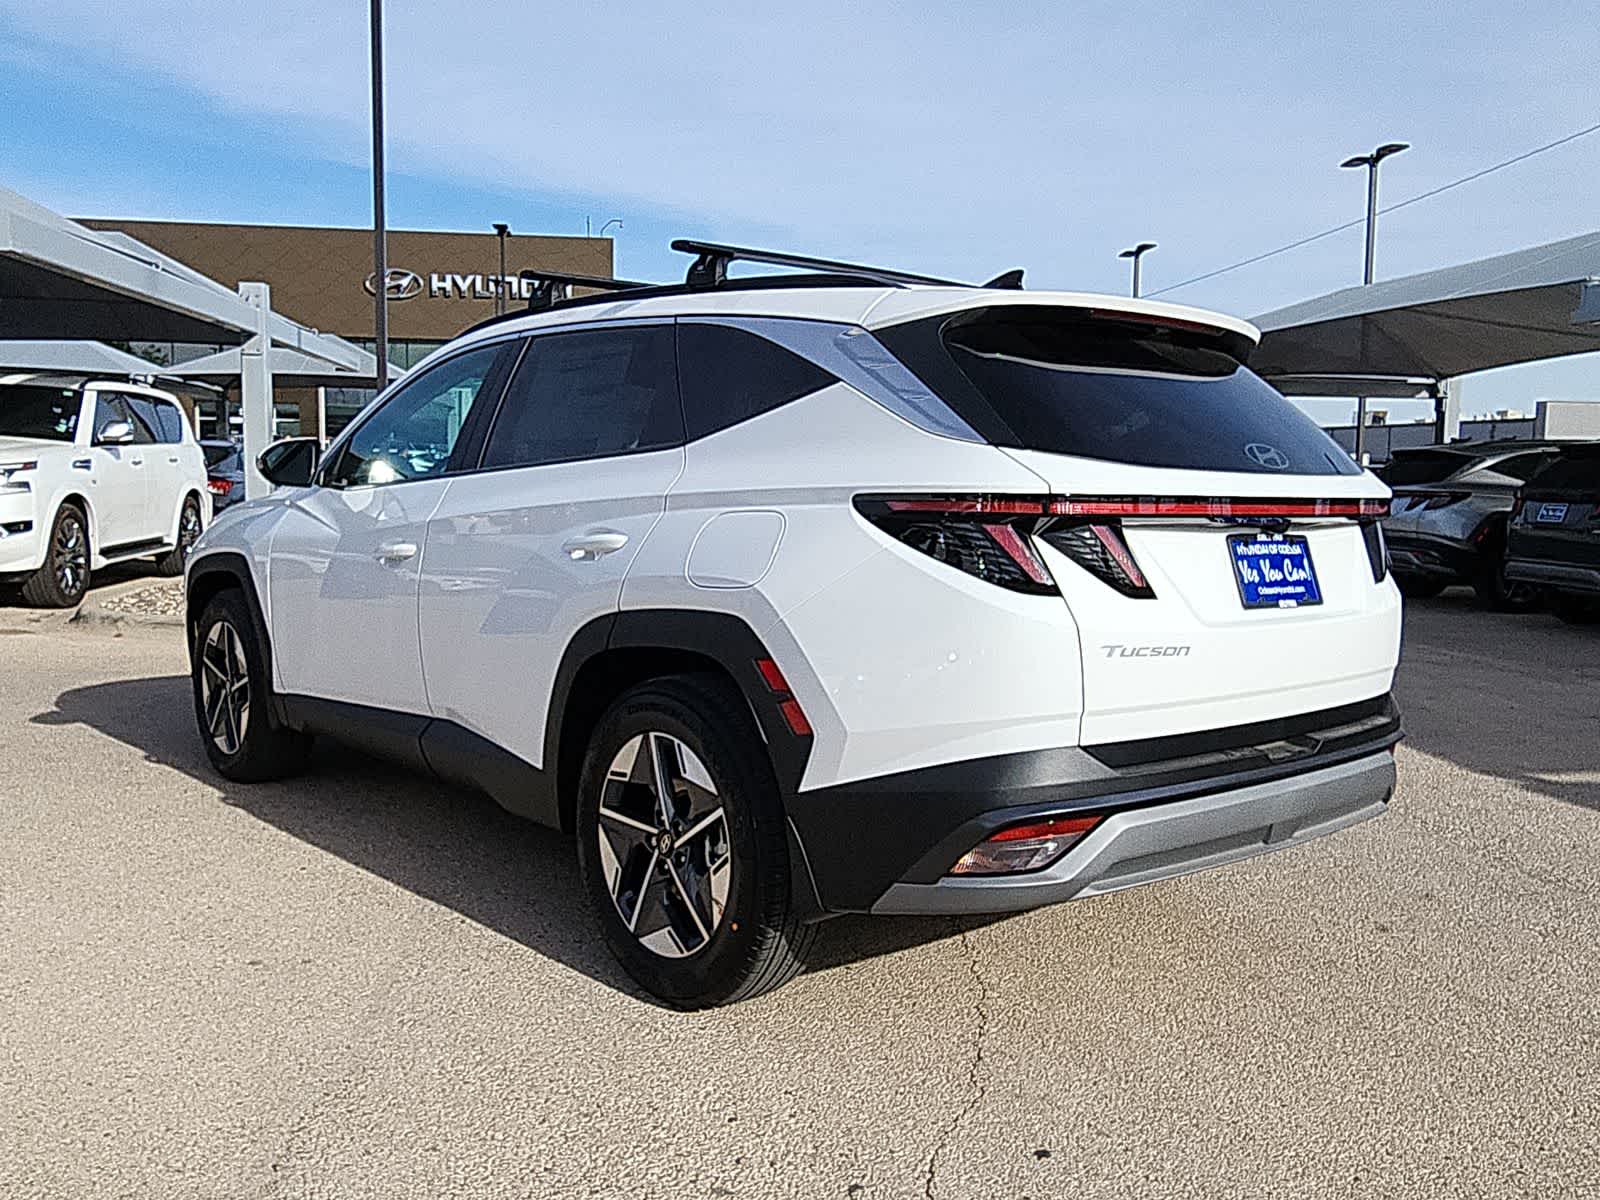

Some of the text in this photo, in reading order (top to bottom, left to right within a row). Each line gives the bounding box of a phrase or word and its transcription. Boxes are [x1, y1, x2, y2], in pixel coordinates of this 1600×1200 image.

[431, 273, 572, 300] HYUNDI
[1238, 557, 1312, 583] Yes You Can!
